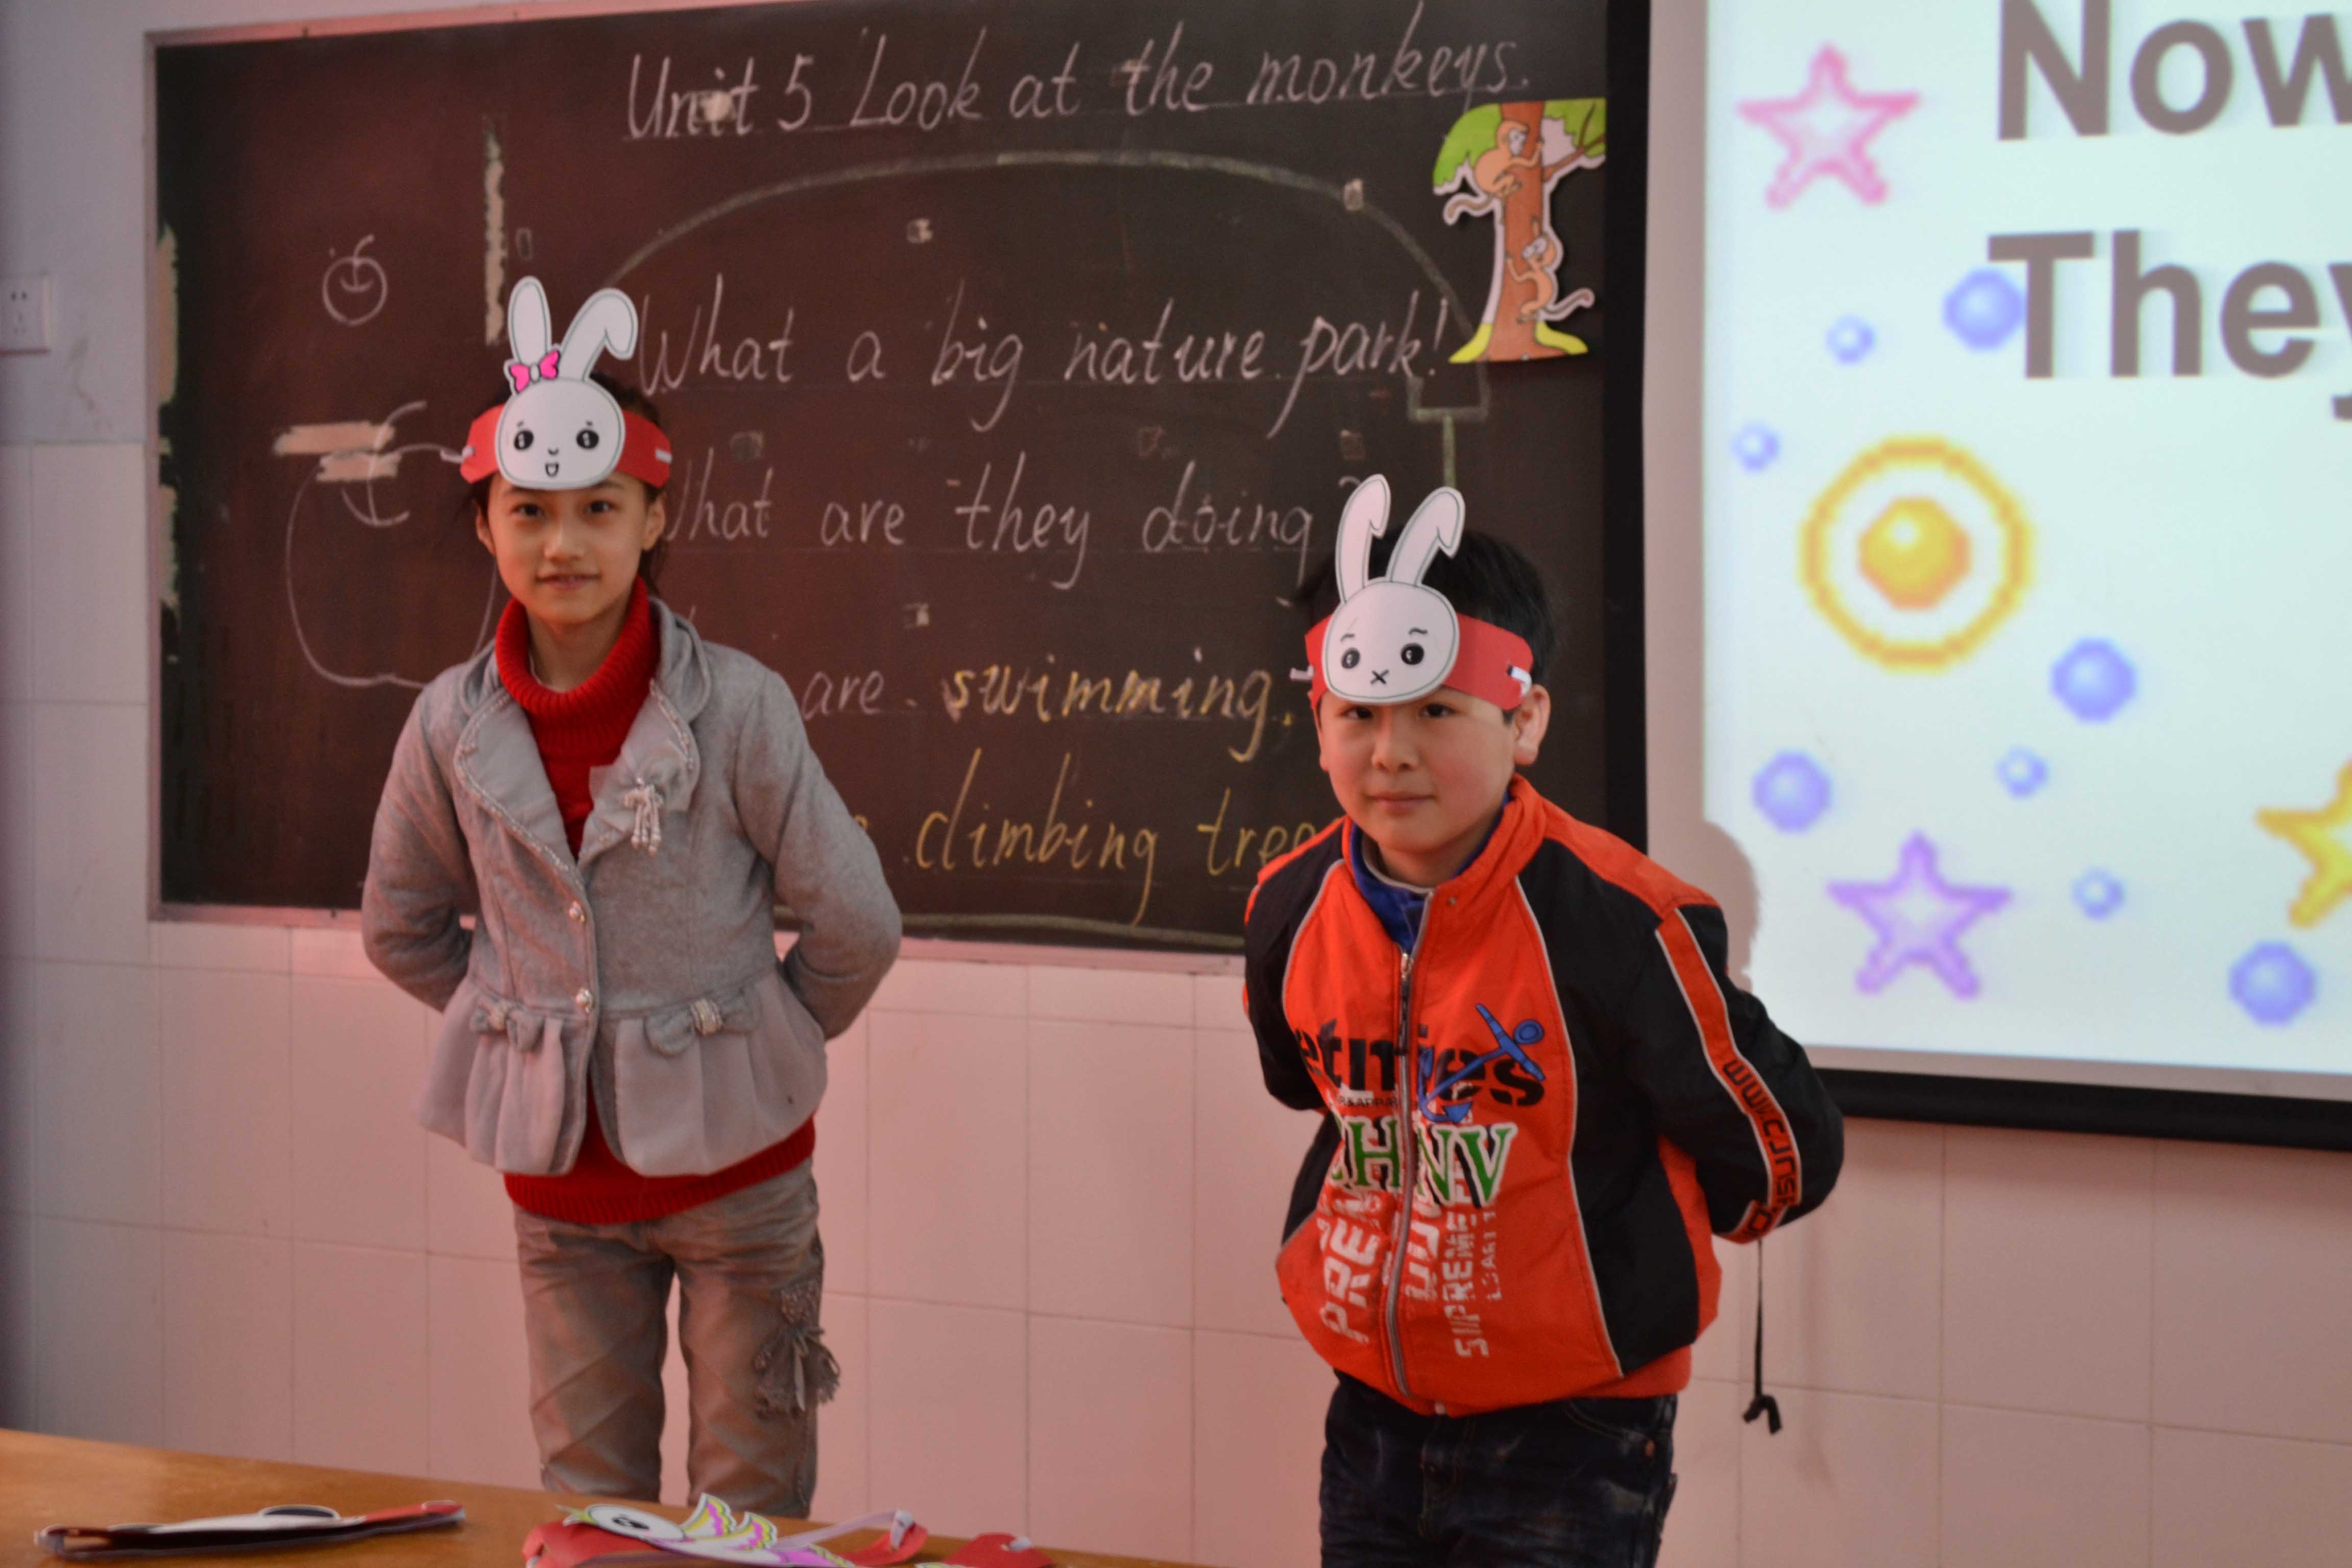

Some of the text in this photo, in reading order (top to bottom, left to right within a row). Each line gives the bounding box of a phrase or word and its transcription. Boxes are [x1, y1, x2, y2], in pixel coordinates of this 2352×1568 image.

[627, 0, 1529, 138] Unit 5 Look at the monkeys.
[1997, 0, 2352, 141] Now
[639, 272, 1449, 439] What a big nature park!
[1987, 228, 2352, 422] The
[820, 500, 905, 546] are
[955, 451, 1090, 590] they
[1141, 460, 1313, 607] doing
[801, 670, 885, 720] are
[916, 747, 1158, 928] climbing
